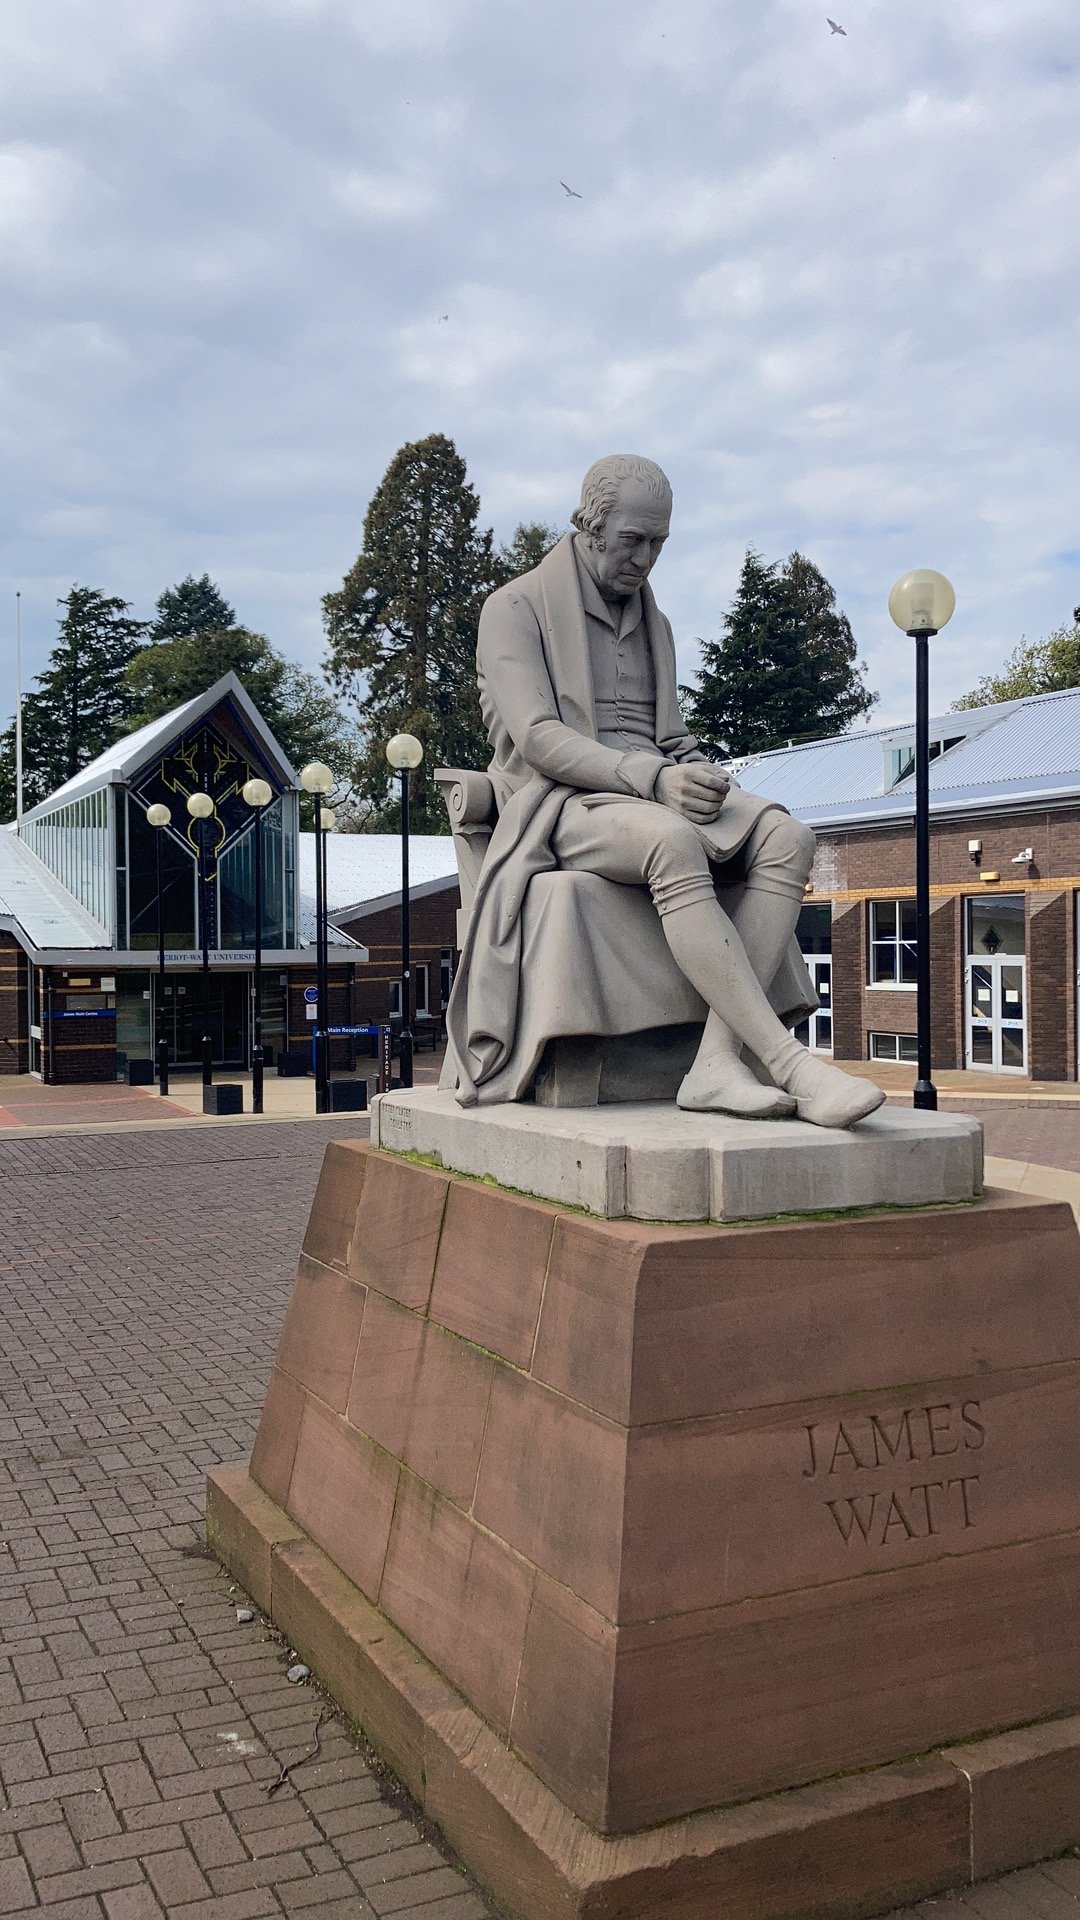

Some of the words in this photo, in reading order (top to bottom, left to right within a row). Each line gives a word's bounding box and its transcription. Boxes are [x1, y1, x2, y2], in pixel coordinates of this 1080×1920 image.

[213, 953, 256, 961] UNIVERSIT
[801, 1400, 985, 1478] JAMES
[824, 1475, 980, 1546] WATT
